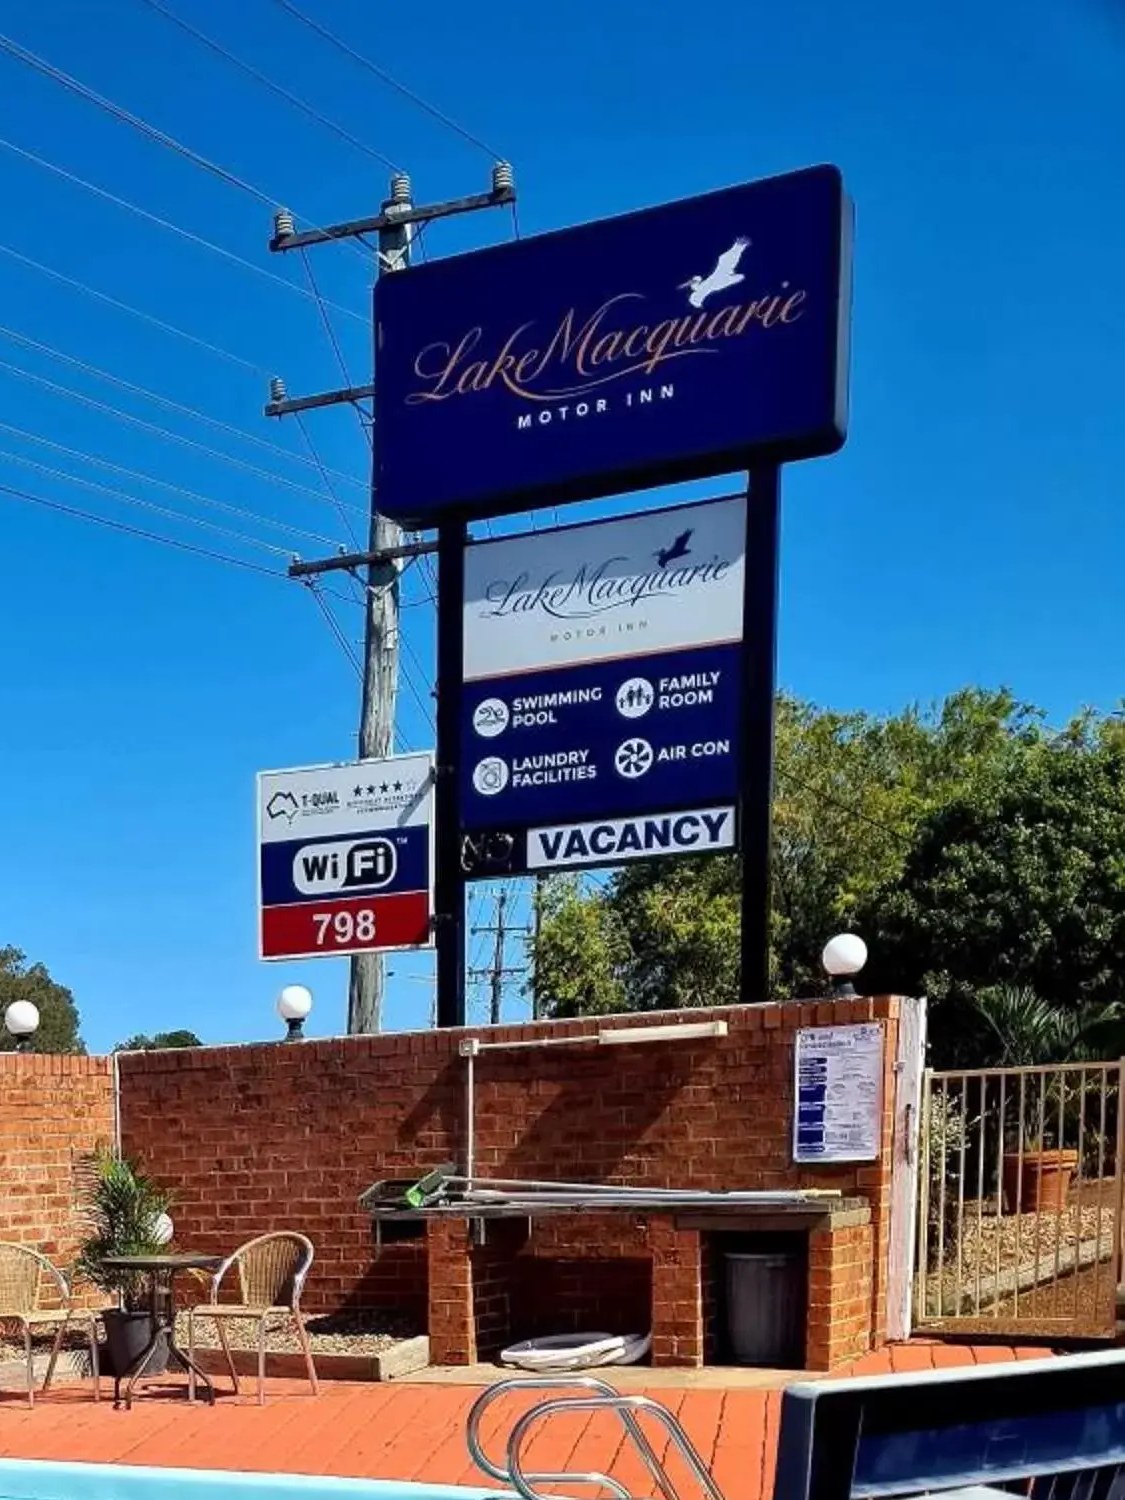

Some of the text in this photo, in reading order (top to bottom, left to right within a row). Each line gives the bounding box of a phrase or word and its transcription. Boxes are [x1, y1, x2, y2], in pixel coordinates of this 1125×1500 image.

[517, 384, 676, 429] MOTOR INN
[550, 627, 607, 642] MOTOR
[659, 671, 721, 693] FAMILY
[512, 687, 603, 712] SWIMMING
[659, 690, 713, 709] ROOM
[512, 711, 558, 729] POOL
[512, 749, 590, 772] LAUNDRY
[657, 740, 730, 762] AIR CON
[512, 765, 597, 788] FACILITIES
[538, 812, 729, 860] VACANCY
[312, 909, 376, 946] 798
